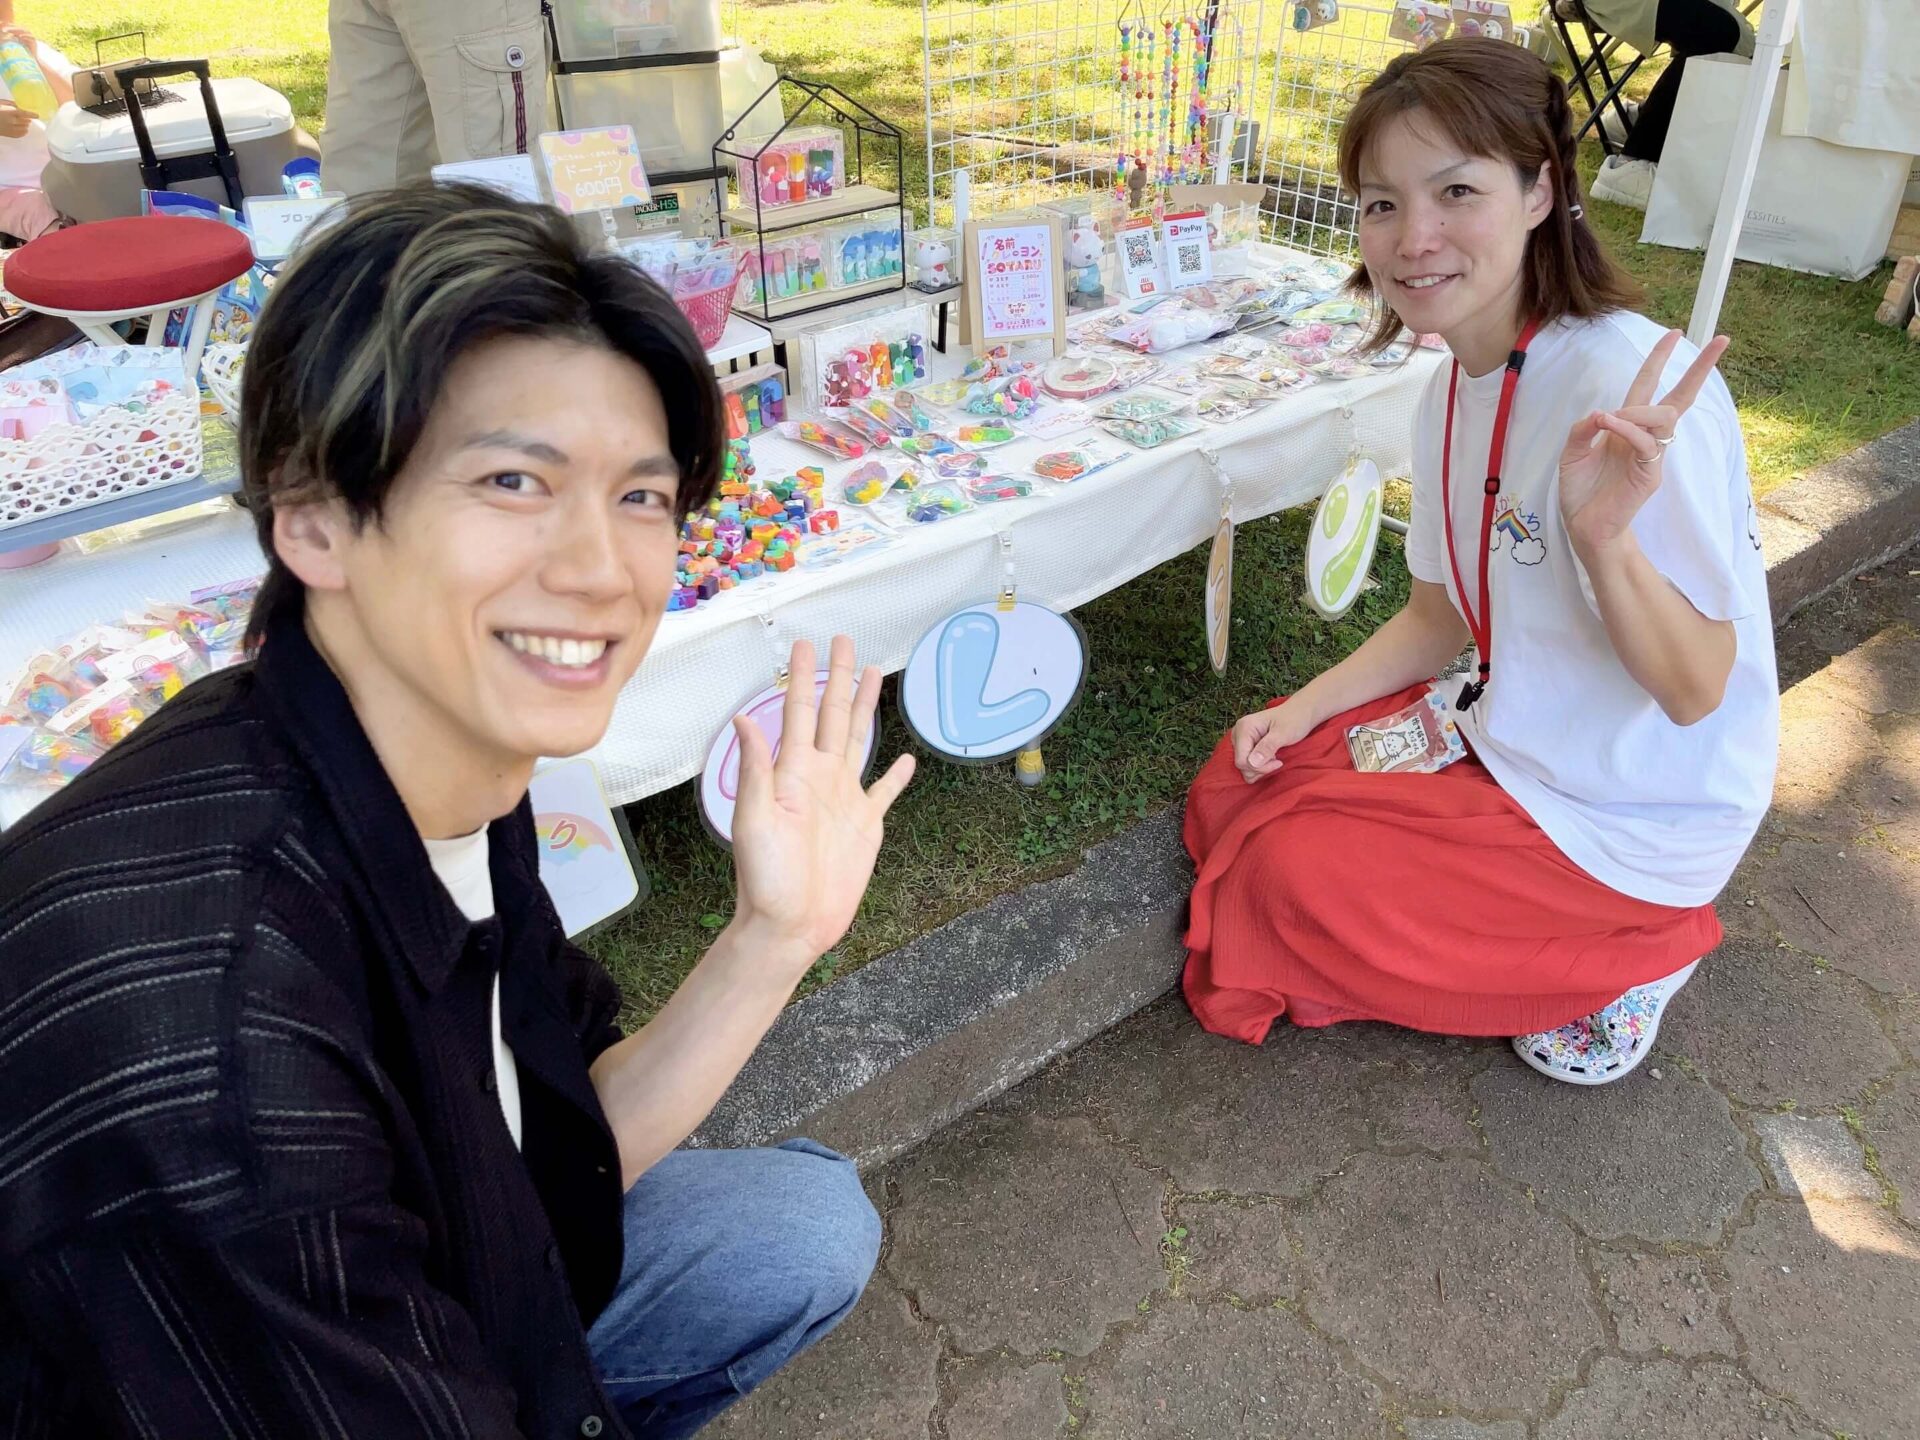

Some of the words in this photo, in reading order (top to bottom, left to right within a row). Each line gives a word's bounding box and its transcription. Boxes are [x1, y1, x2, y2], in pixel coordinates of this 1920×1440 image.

[565, 160, 621, 180] ドーナツ
[575, 176, 623, 197] 600円
[1744, 209, 1786, 225] ESSITIES
[1179, 224, 1203, 233] PayPay
[994, 237, 1016, 251] 名前
